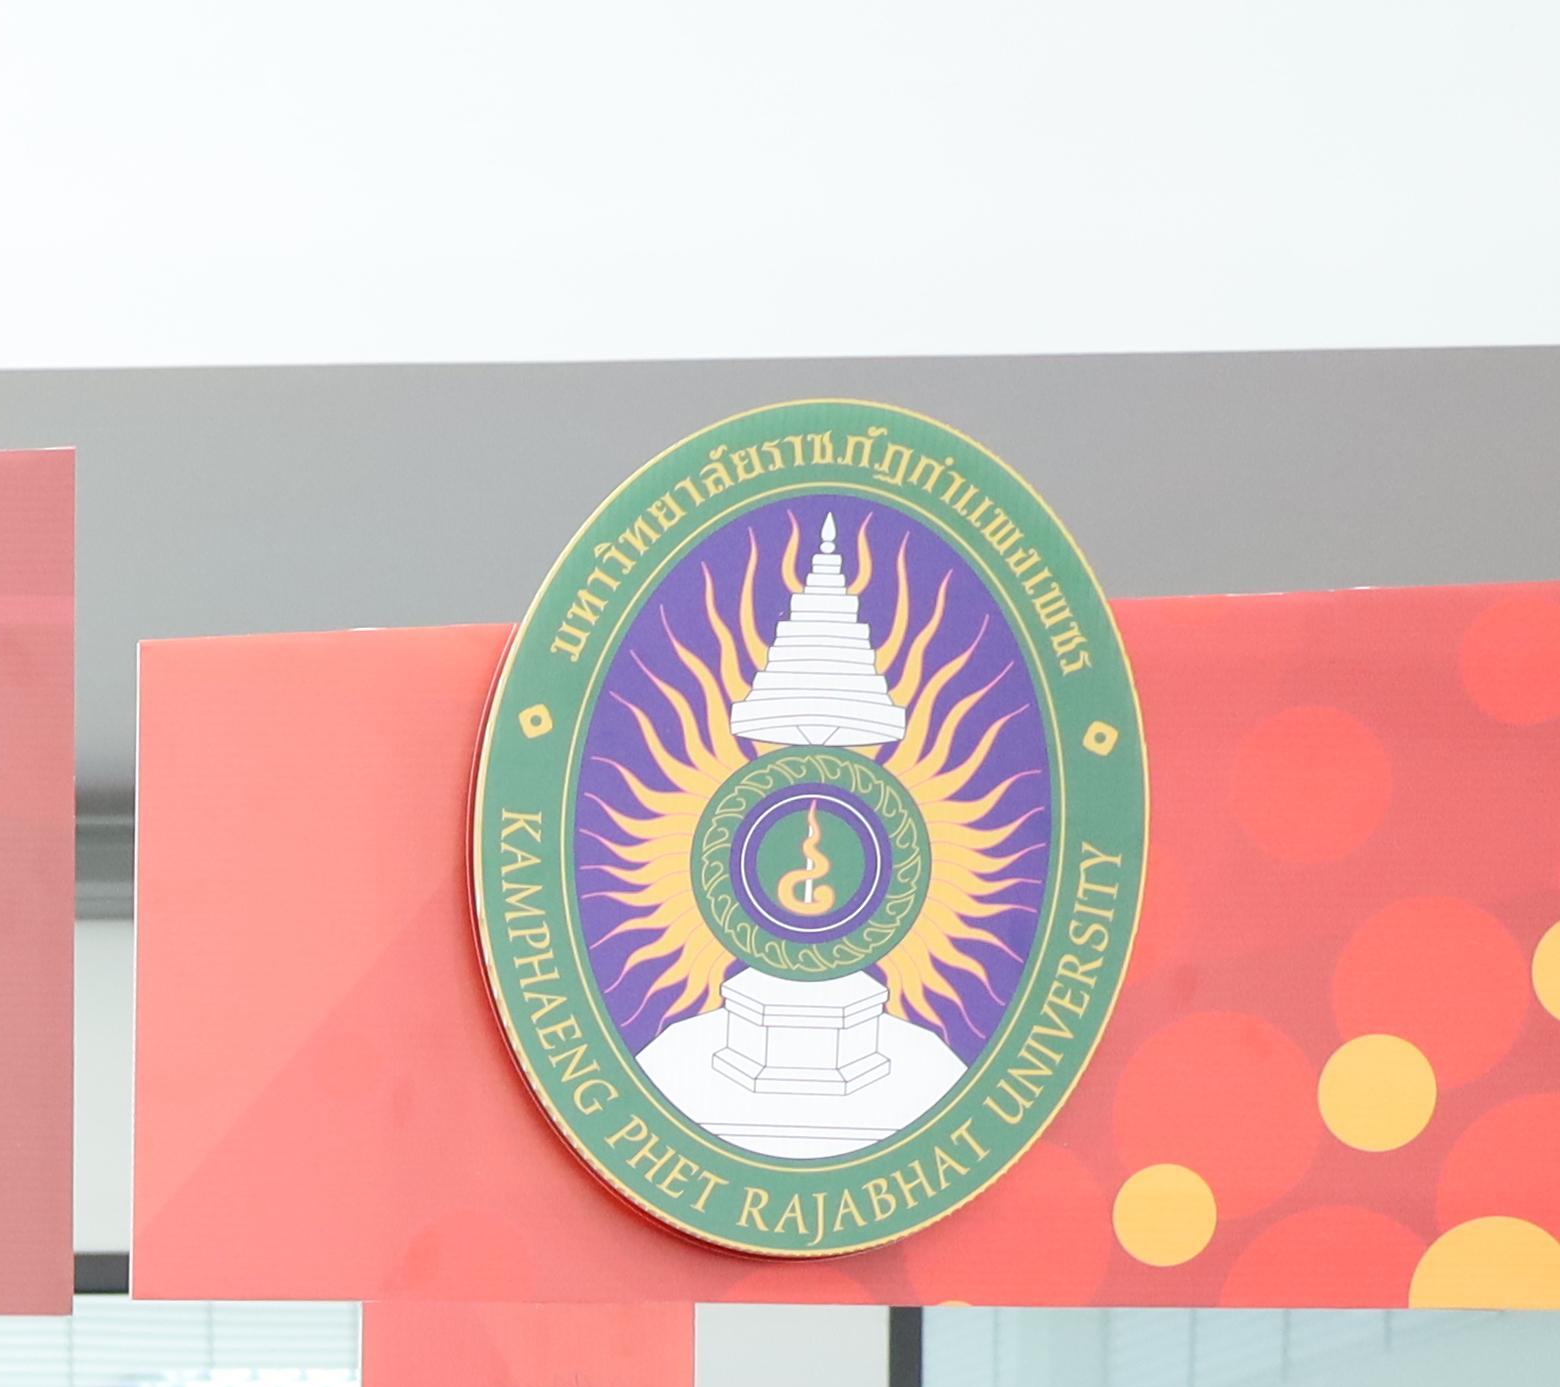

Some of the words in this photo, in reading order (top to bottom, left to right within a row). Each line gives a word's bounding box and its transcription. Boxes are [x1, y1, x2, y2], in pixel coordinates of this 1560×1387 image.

[500, 807, 619, 1116] KAMPHAENG
[604, 1114, 730, 1214] PHET
[736, 1118, 991, 1246] RAJABHAT
[982, 840, 1122, 1126] UNIVERSITY
